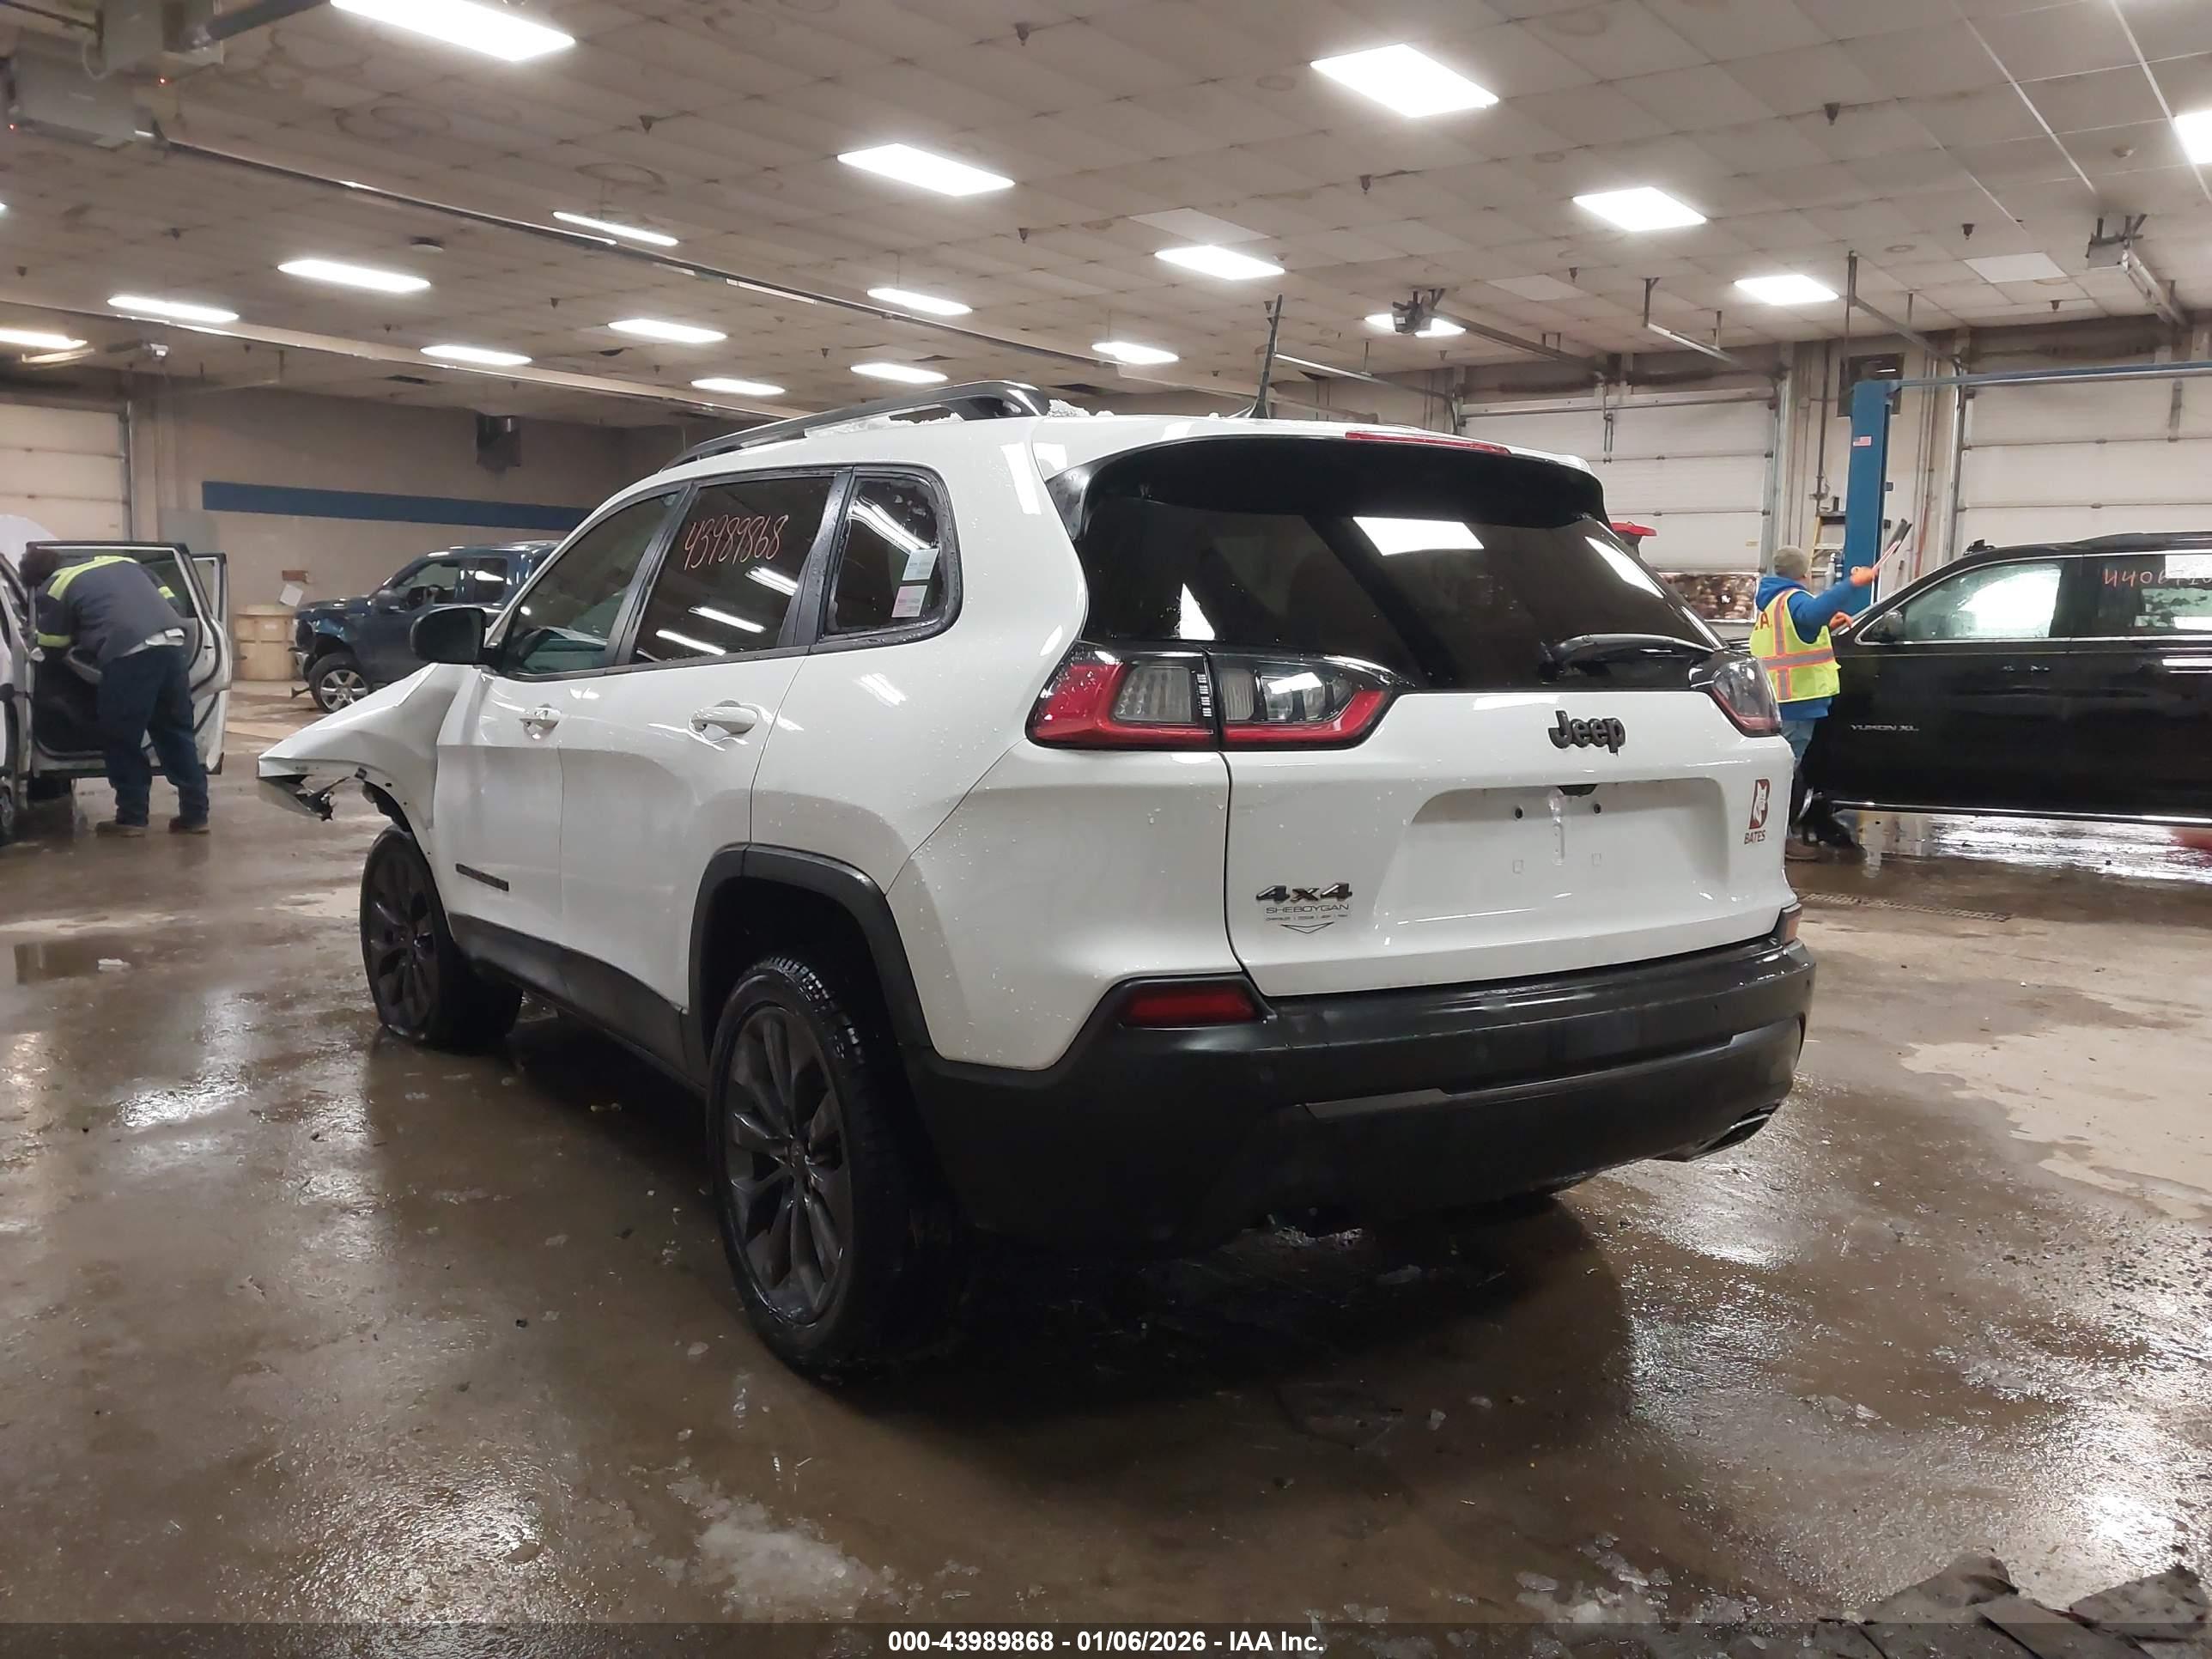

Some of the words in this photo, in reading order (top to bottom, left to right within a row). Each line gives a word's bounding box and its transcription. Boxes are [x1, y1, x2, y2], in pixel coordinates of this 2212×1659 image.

[684, 514, 789, 571] 43989868
[1548, 710, 1626, 756] Jeep
[1744, 830, 1766, 844] BATES
[1266, 904, 1350, 915] SHEBOYGAN
